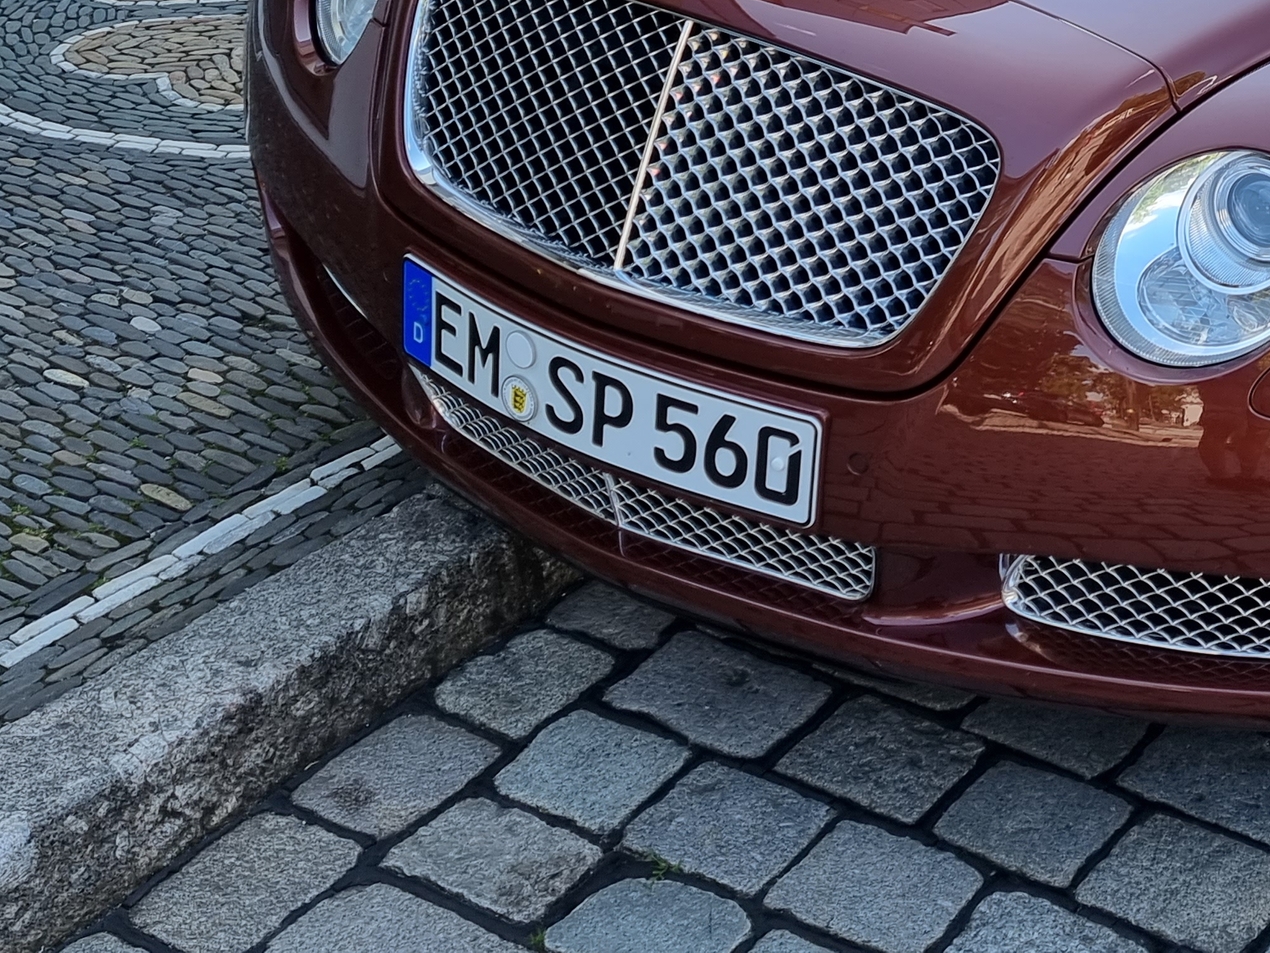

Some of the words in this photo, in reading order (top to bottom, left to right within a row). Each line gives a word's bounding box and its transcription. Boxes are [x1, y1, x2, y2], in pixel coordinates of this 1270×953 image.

[413, 321, 424, 344] D
[434, 291, 501, 398] EM
[545, 356, 634, 447] SP
[653, 393, 801, 506] 560
